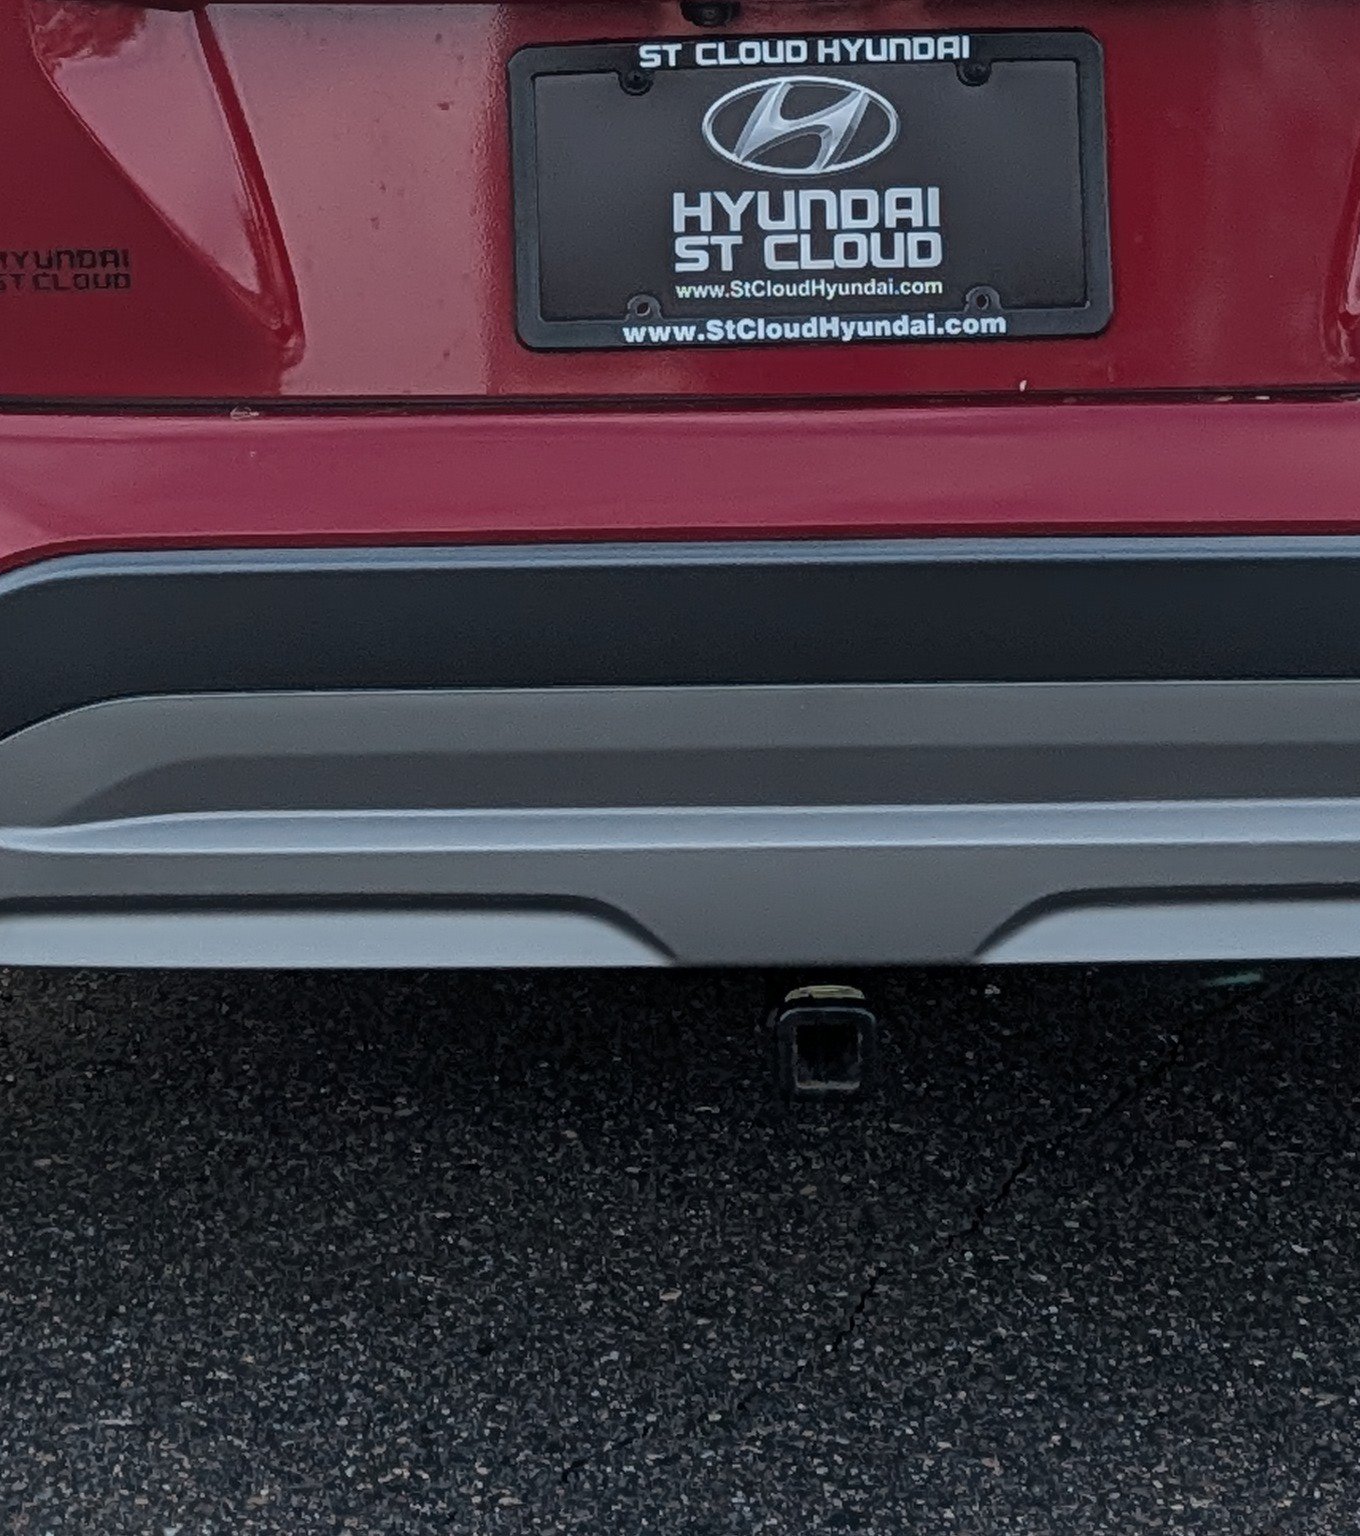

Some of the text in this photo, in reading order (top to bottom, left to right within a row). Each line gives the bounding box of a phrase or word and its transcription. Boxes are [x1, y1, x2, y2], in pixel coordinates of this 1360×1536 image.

[639, 35, 971, 68] ST CLOUD HYUNDAI
[672, 187, 941, 233] HYUNDAI
[674, 231, 943, 273] ST CLOUD
[32, 272, 132, 291] CLOUD
[675, 278, 944, 301] www.StCloudHyundai.com
[622, 312, 1007, 344] www.StCloudHyundai.com
